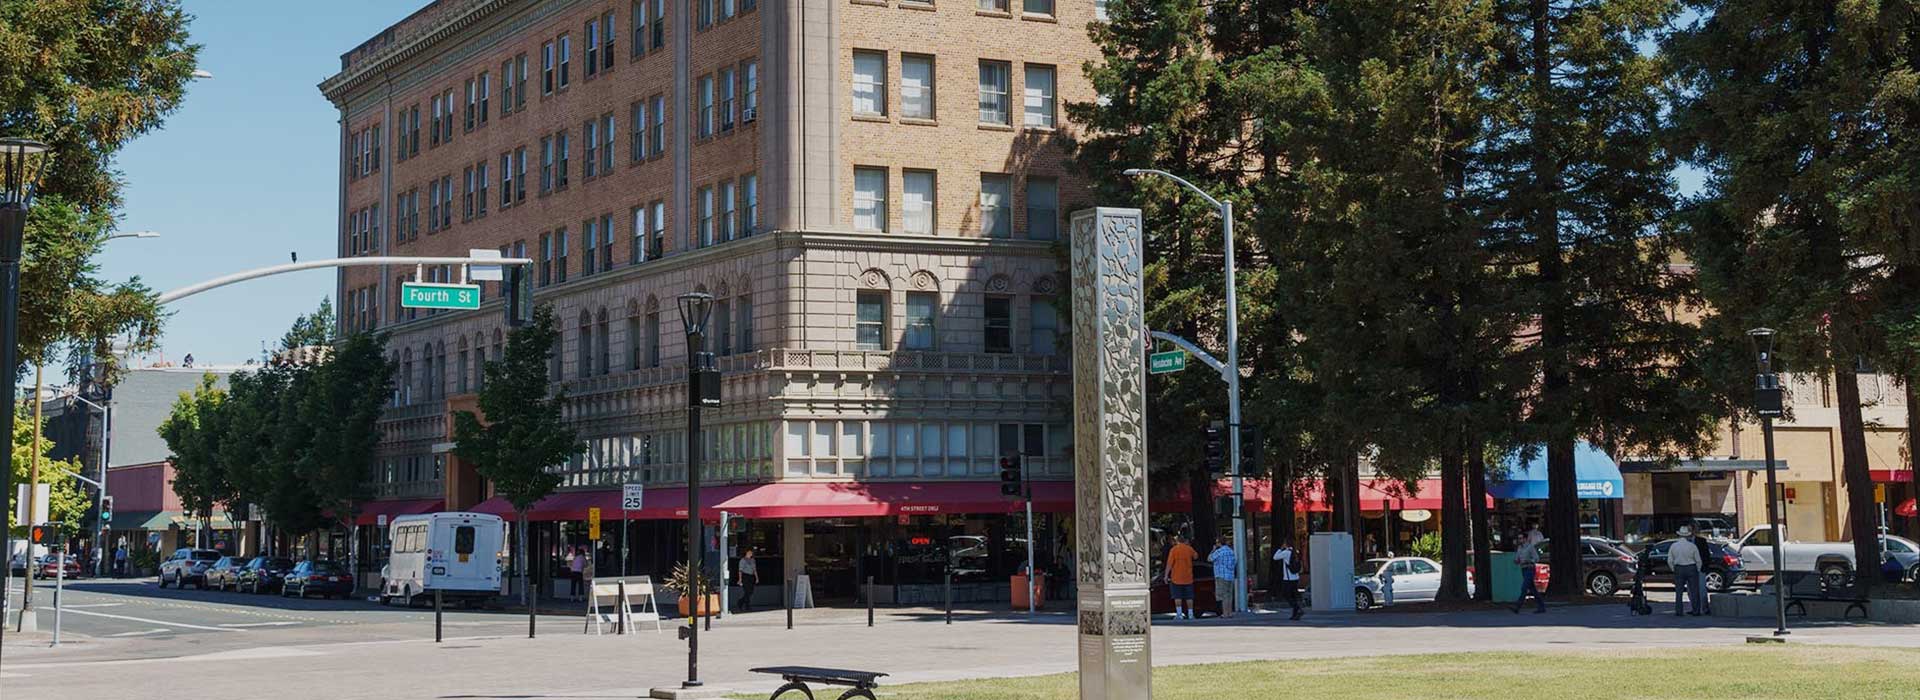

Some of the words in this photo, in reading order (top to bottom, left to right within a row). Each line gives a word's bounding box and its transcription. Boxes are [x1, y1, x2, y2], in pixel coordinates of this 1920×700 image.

[410, 288, 449, 303] Fourth
[458, 290, 472, 304] St
[624, 497, 641, 508] 25
[911, 537, 929, 545] OPEN
